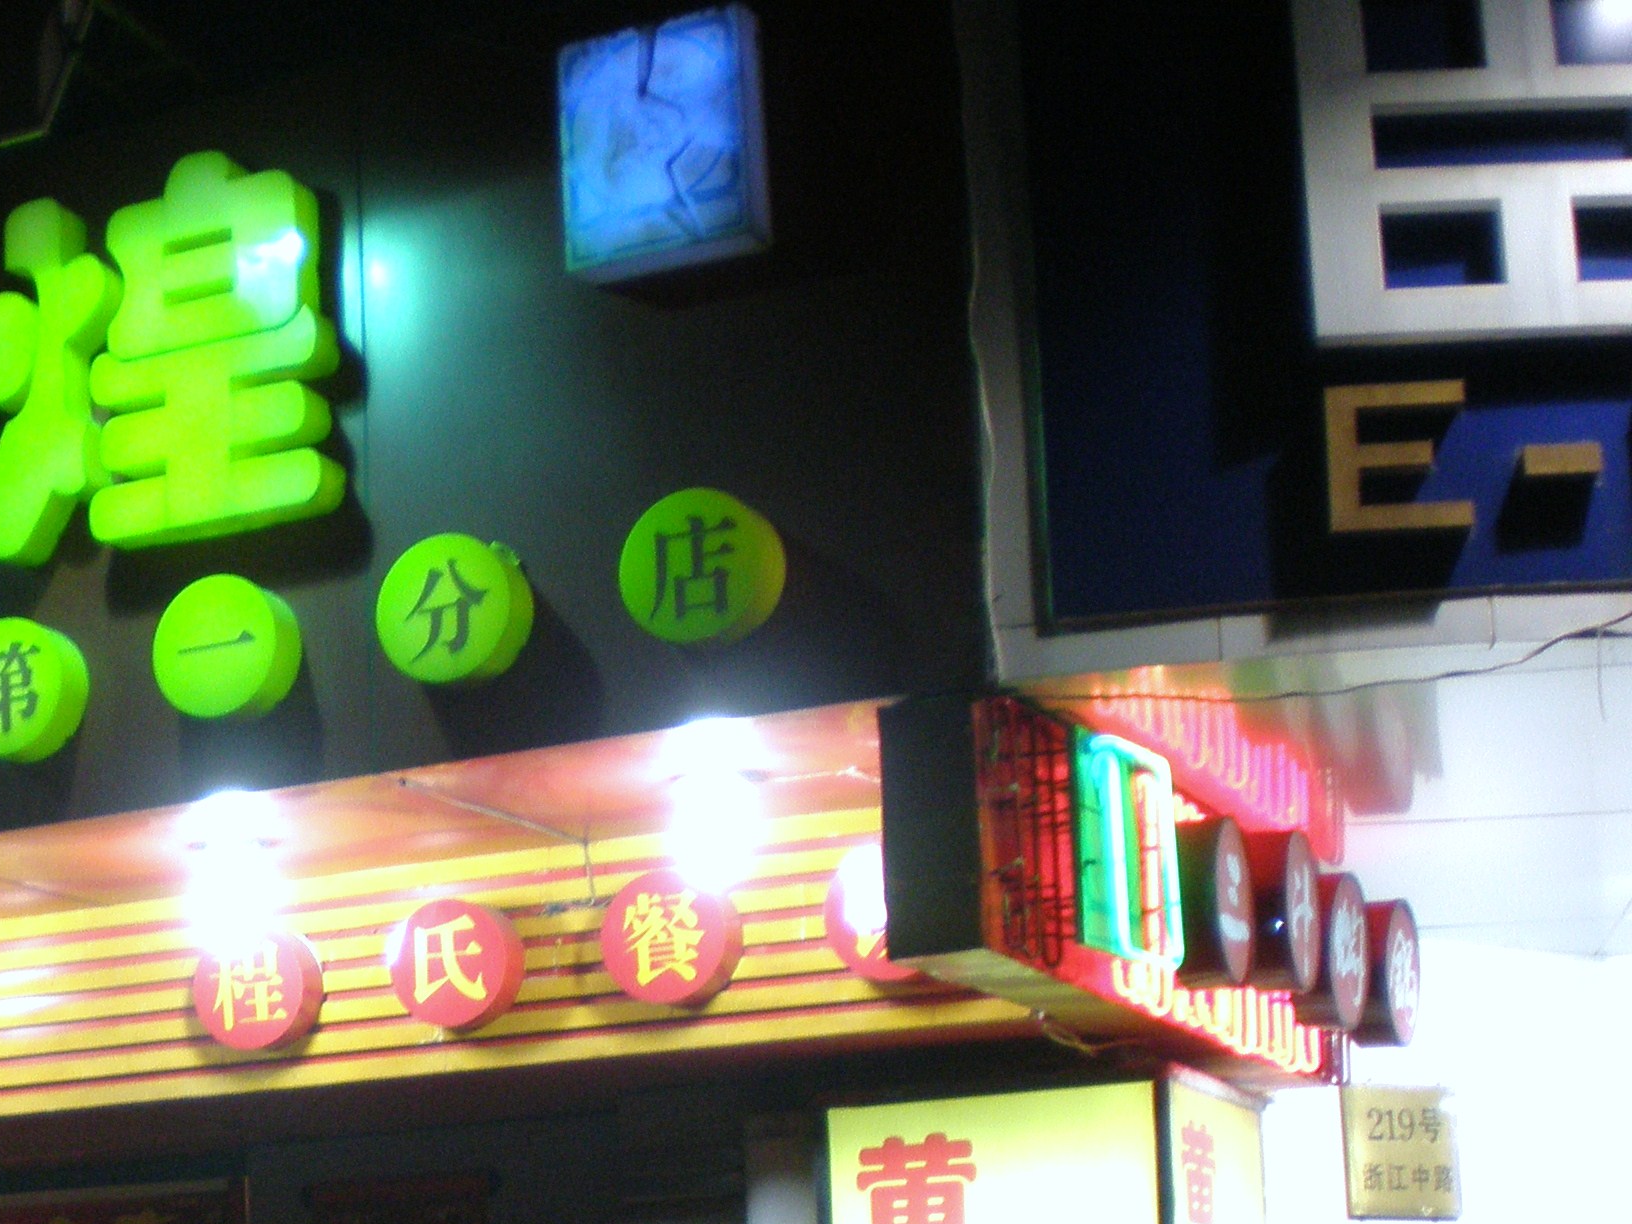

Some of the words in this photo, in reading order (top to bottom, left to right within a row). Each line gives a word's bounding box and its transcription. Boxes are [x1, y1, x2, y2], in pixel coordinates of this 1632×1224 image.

[1366, 1107, 1443, 1143] 219号
[1362, 1163, 1453, 1194] 浙江中路
